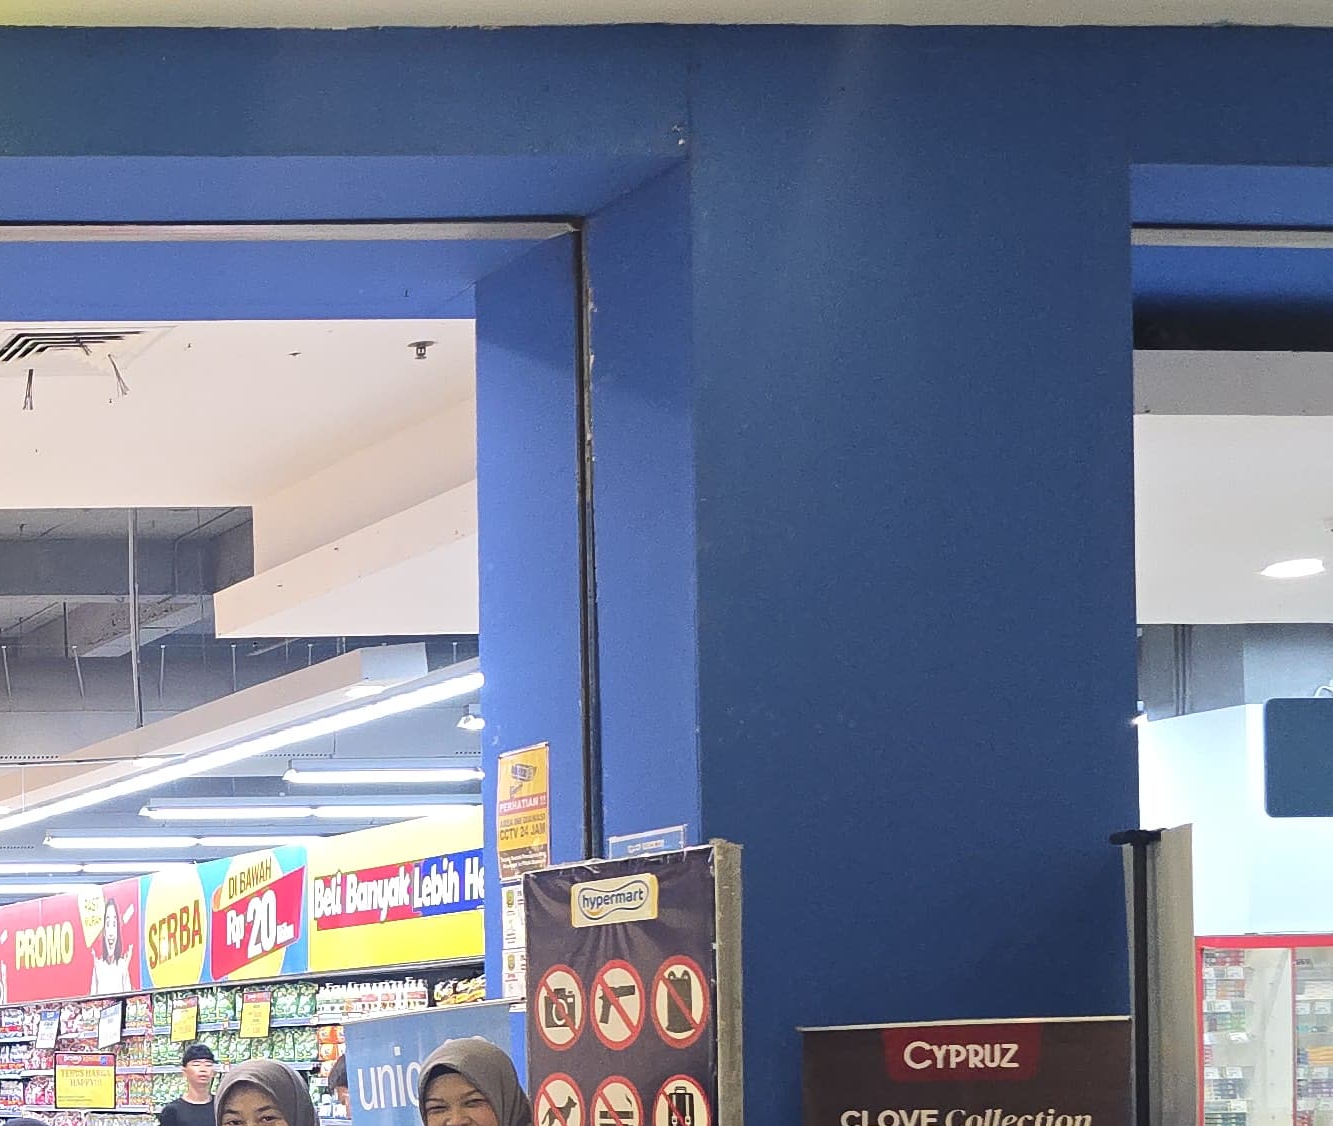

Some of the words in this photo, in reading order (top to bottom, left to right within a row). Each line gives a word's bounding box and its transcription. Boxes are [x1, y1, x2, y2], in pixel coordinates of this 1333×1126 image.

[500, 826, 519, 841] CCTV
[531, 822, 546, 837] JAM
[228, 876, 238, 899] DI
[239, 856, 272, 895] BAWAH
[314, 869, 342, 921] Beli
[345, 862, 410, 922] Banyak
[413, 853, 459, 909] Lebih
[583, 888, 643, 910] hypermart
[15, 921, 74, 971] PROMO
[148, 899, 202, 969] SERBA
[247, 889, 277, 960] 20
[903, 1041, 1020, 1070] CYPRUZ
